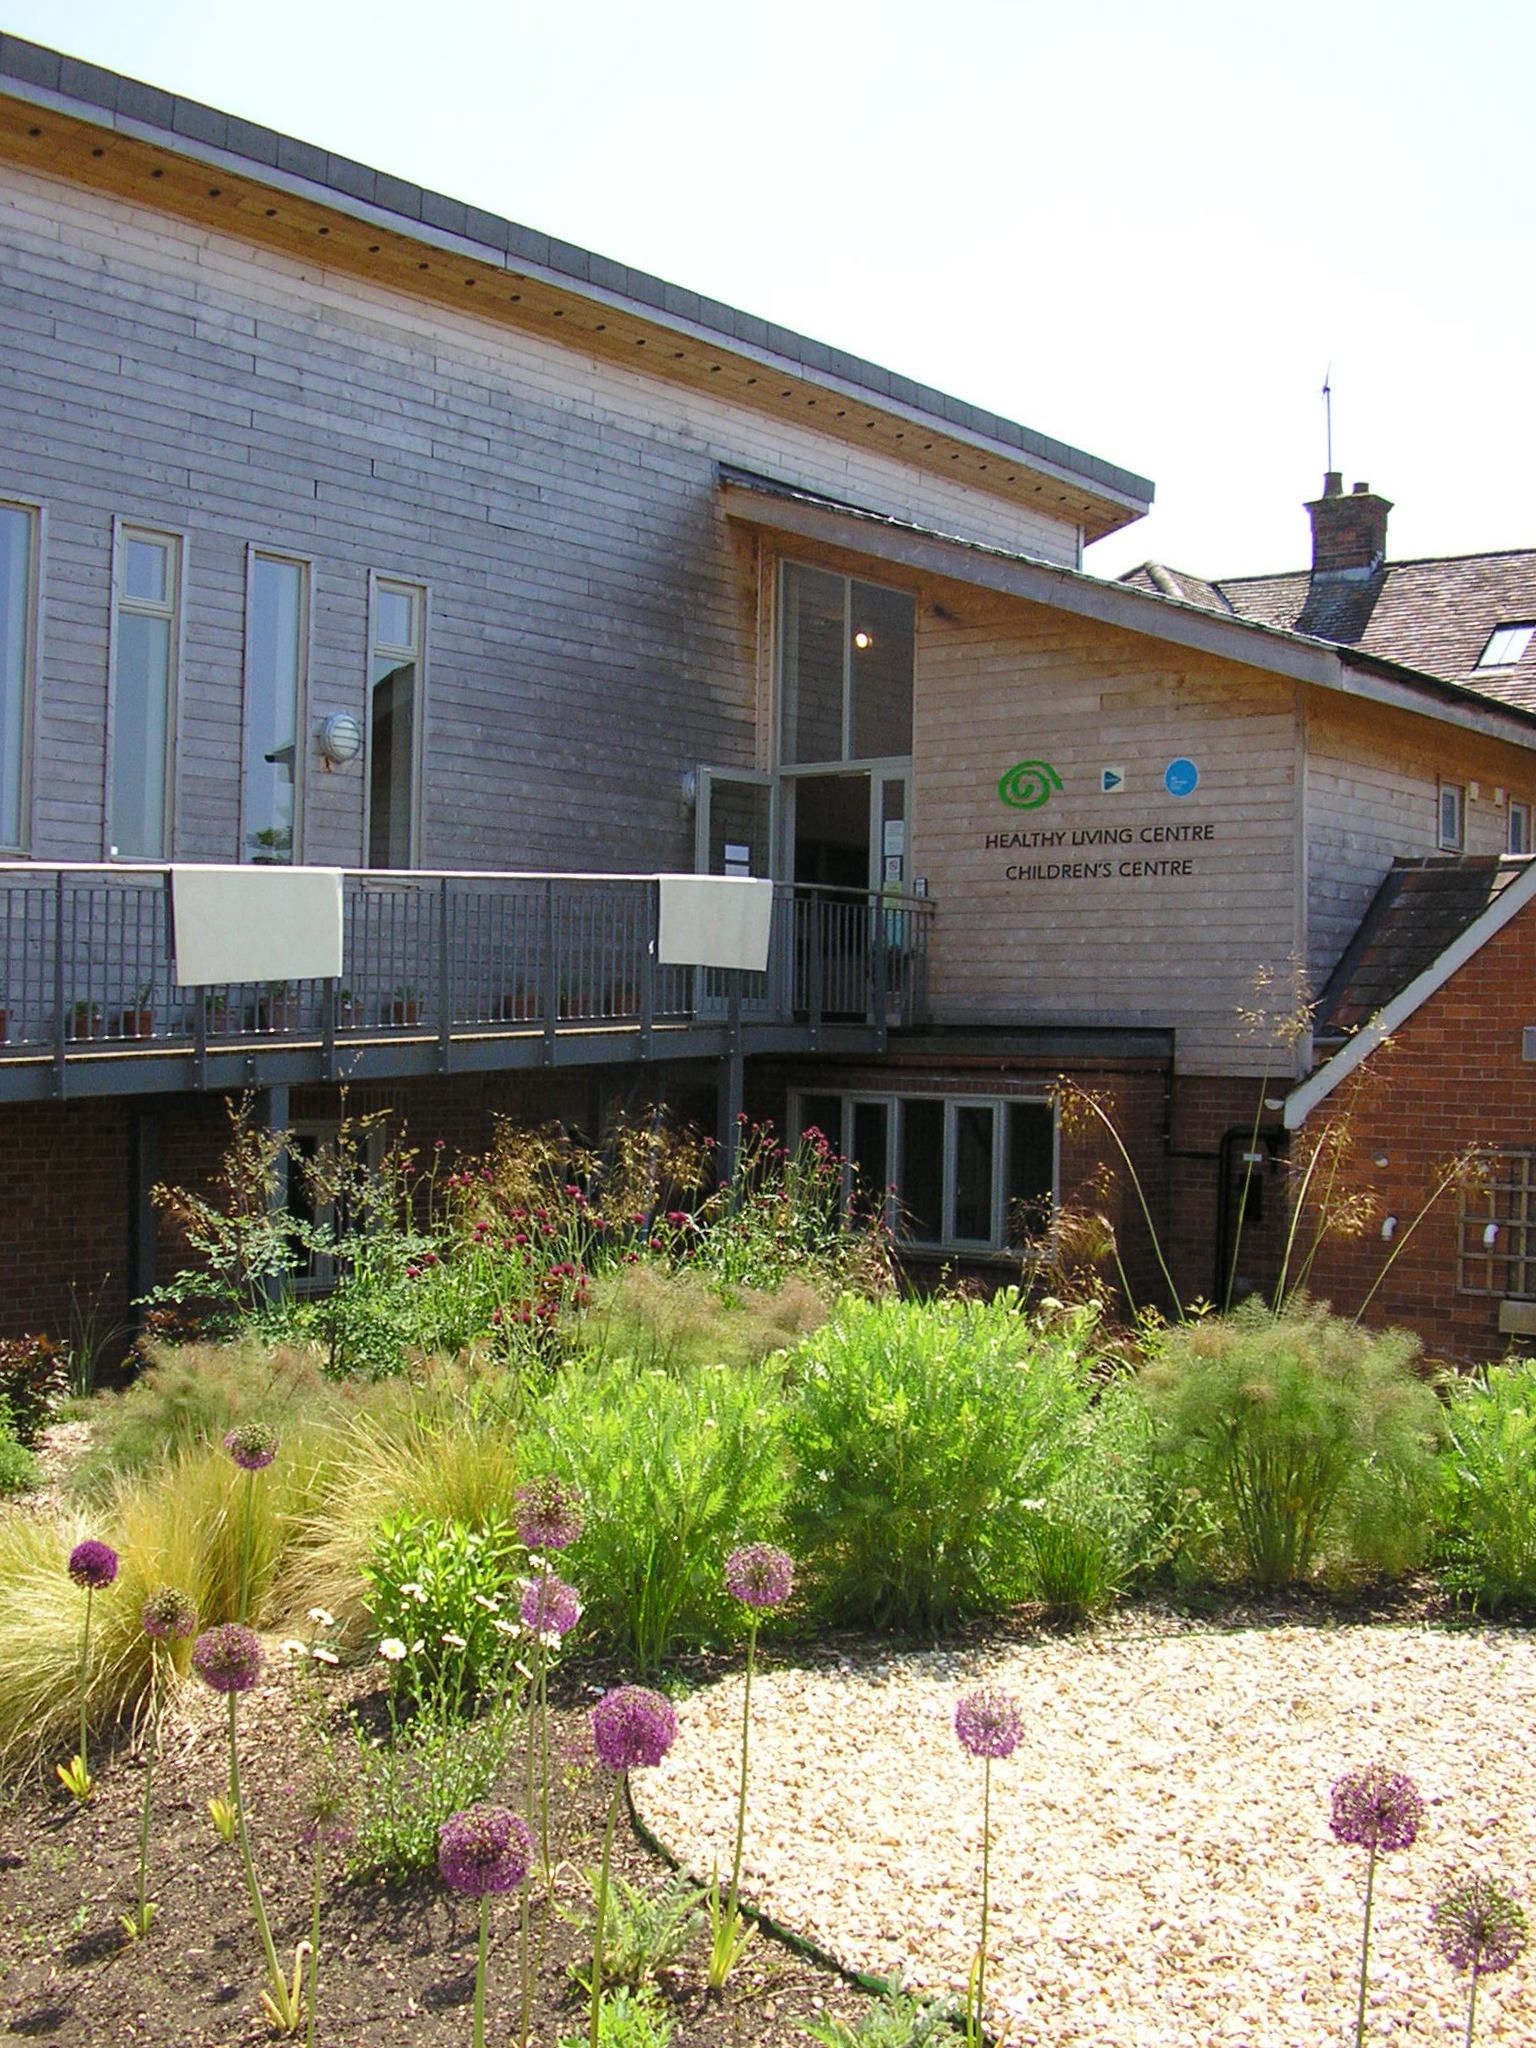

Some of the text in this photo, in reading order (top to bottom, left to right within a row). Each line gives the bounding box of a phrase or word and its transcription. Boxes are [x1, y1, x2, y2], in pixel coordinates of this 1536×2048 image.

[985, 825, 1215, 849] HEALTHY LIVING CENTRE
[1006, 860, 1193, 880] CHILDREN'S CENTRE
